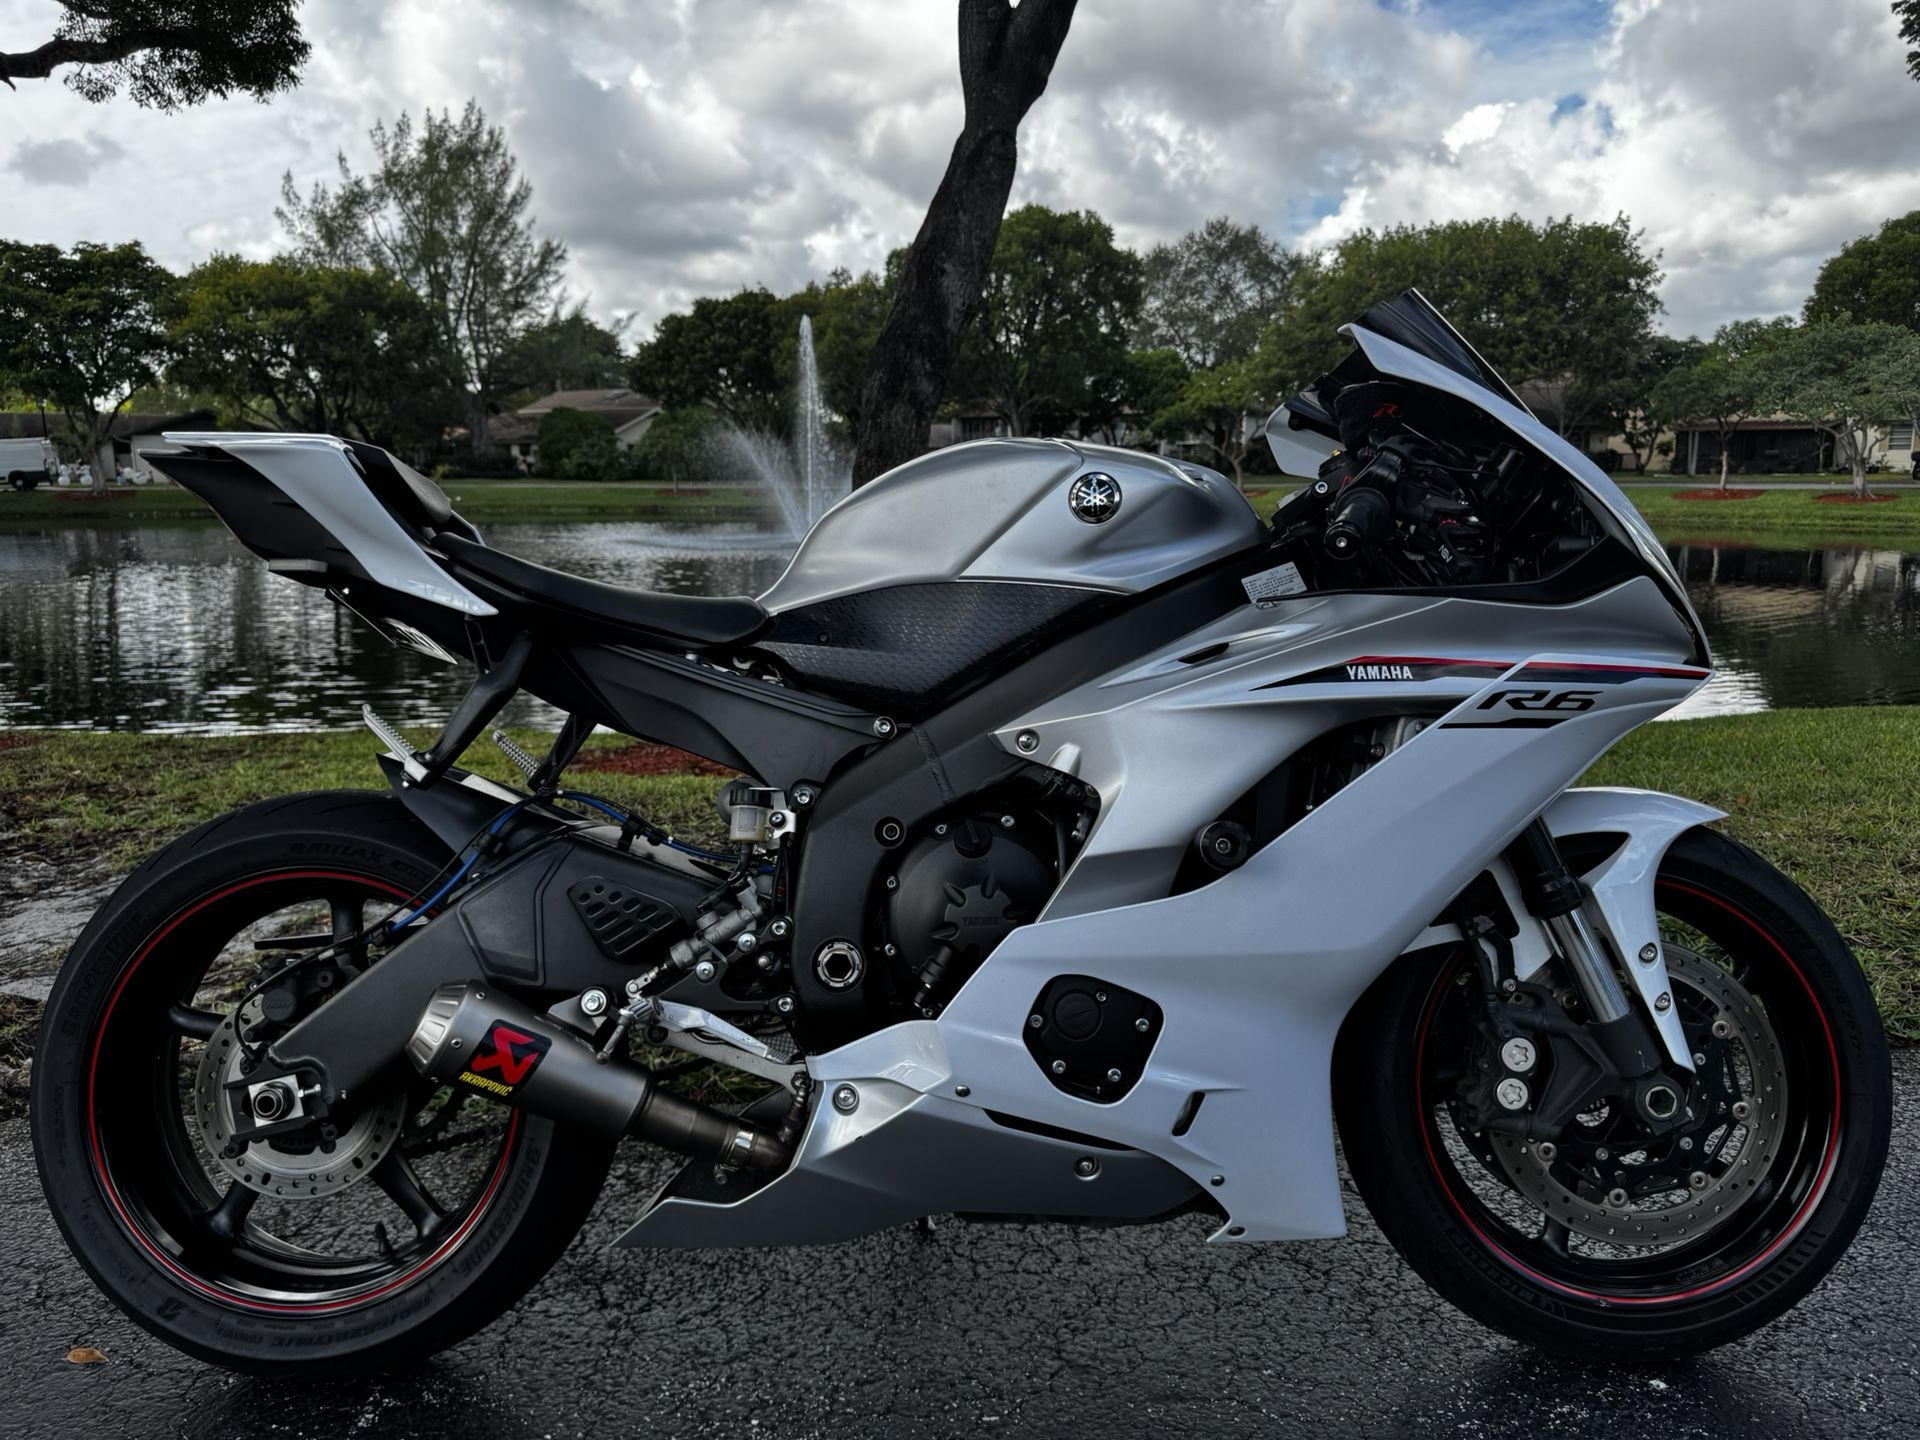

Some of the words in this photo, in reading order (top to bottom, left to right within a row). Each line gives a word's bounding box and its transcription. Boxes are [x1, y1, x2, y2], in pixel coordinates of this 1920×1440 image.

[1346, 665, 1413, 680] YAMAHA
[1476, 689, 1604, 711] R6
[962, 914, 999, 928] YAMAHA
